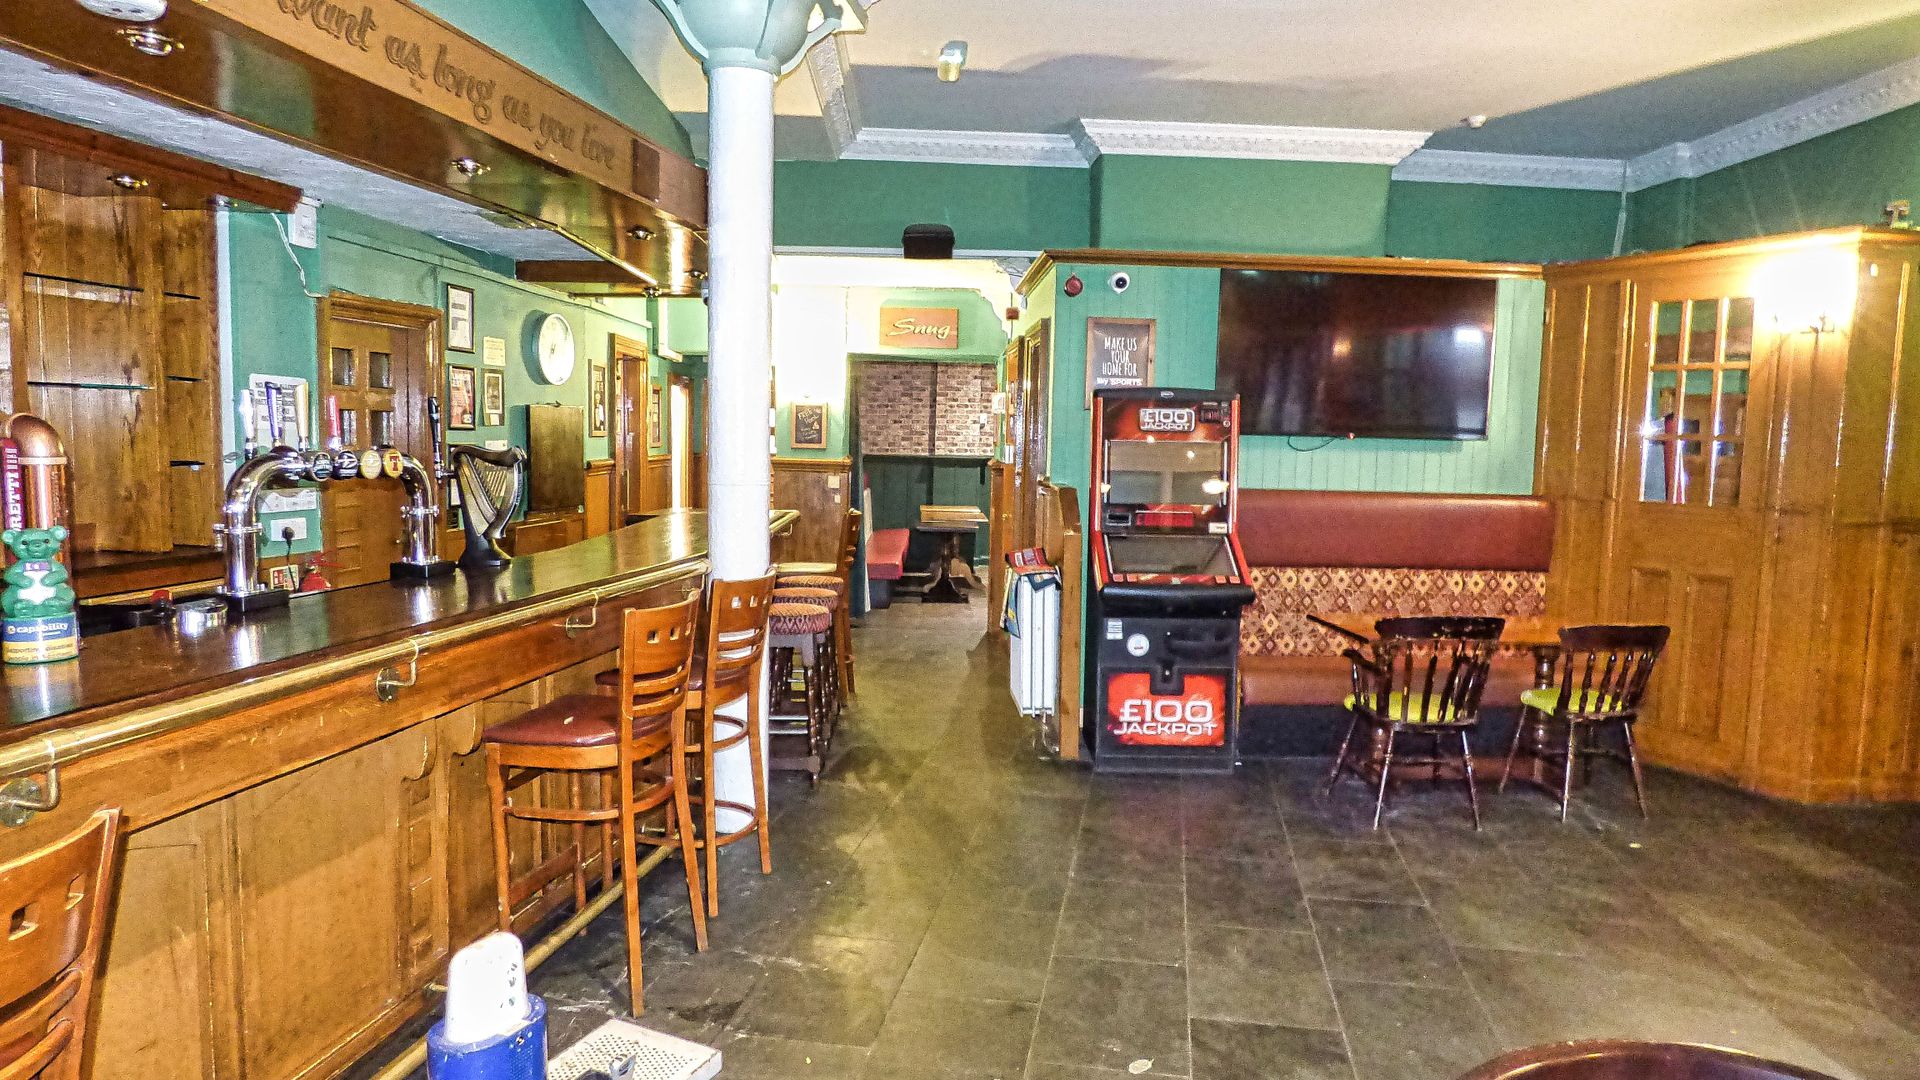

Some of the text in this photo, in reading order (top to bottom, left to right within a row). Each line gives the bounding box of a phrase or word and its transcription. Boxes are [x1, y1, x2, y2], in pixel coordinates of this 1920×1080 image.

[385, 35, 428, 80] as
[434, 43, 496, 124] long
[502, 95, 533, 132] as
[535, 113, 575, 151] you
[886, 318, 950, 340] Snug
[1104, 336, 1138, 351] MAKE US
[1111, 350, 1130, 363] YOUR
[1102, 362, 1138, 376] HOME FOR
[1143, 410, 1188, 423] £100
[1140, 422, 1190, 431] JACKPOT
[5, 471, 23, 531] RETTI
[1119, 698, 1214, 723] £100
[1113, 722, 1219, 736] JACKPOT
